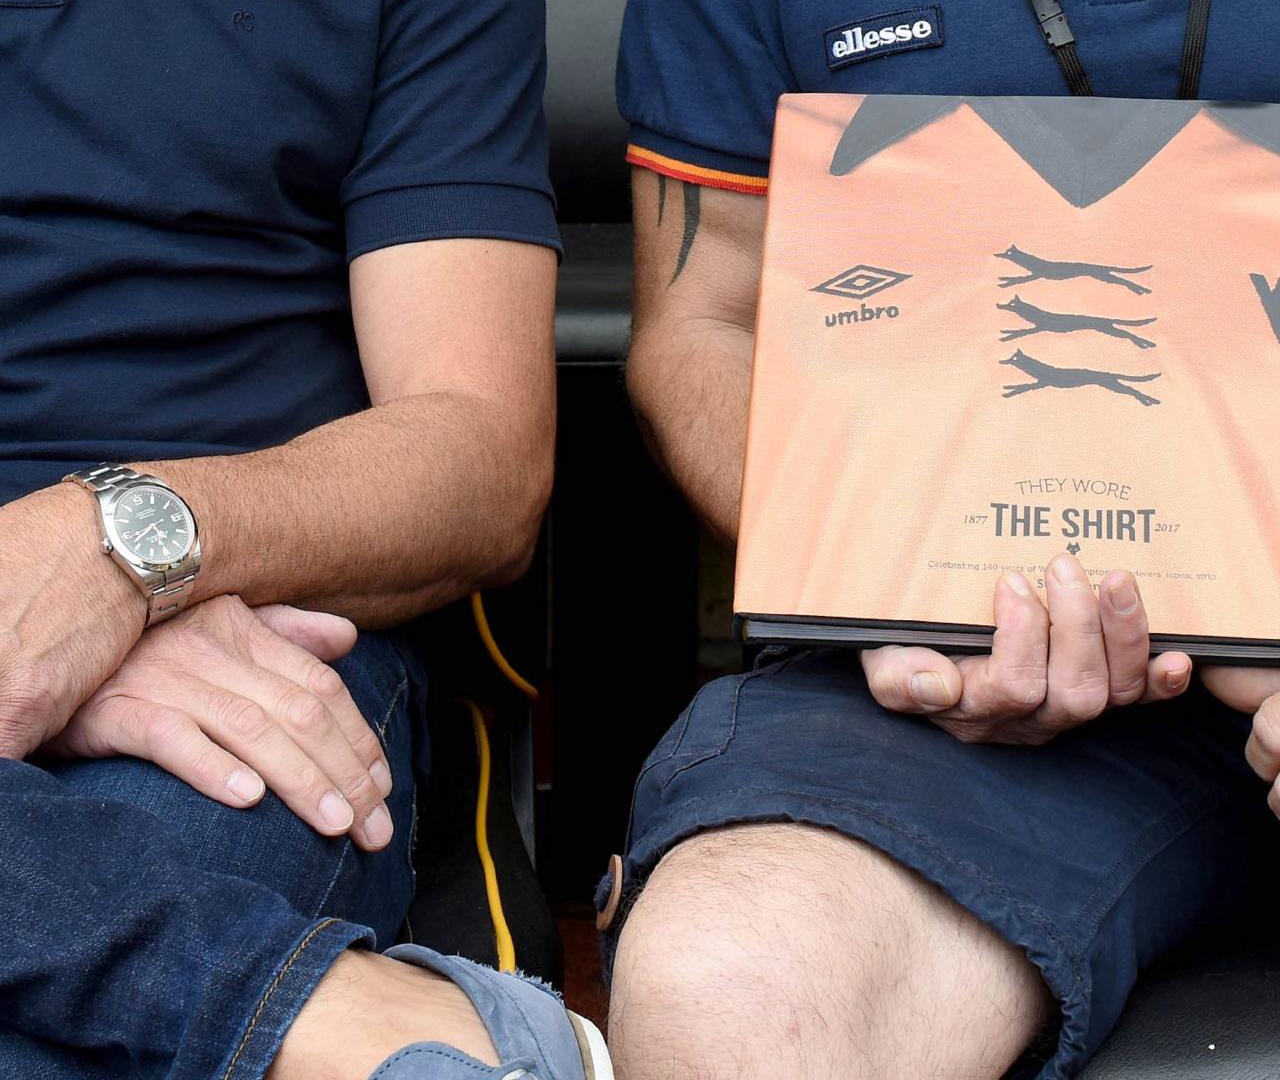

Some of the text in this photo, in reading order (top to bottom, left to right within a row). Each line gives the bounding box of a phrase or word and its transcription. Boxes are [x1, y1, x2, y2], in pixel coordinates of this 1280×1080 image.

[832, 20, 933, 58] ellesse
[825, 303, 899, 327] umbro
[1015, 477, 1132, 500] THEY WORE
[963, 514, 988, 525] 1877
[990, 502, 1156, 544] THE SHIRT
[1154, 523, 1180, 533] 2017
[928, 560, 980, 572] Celebrating
